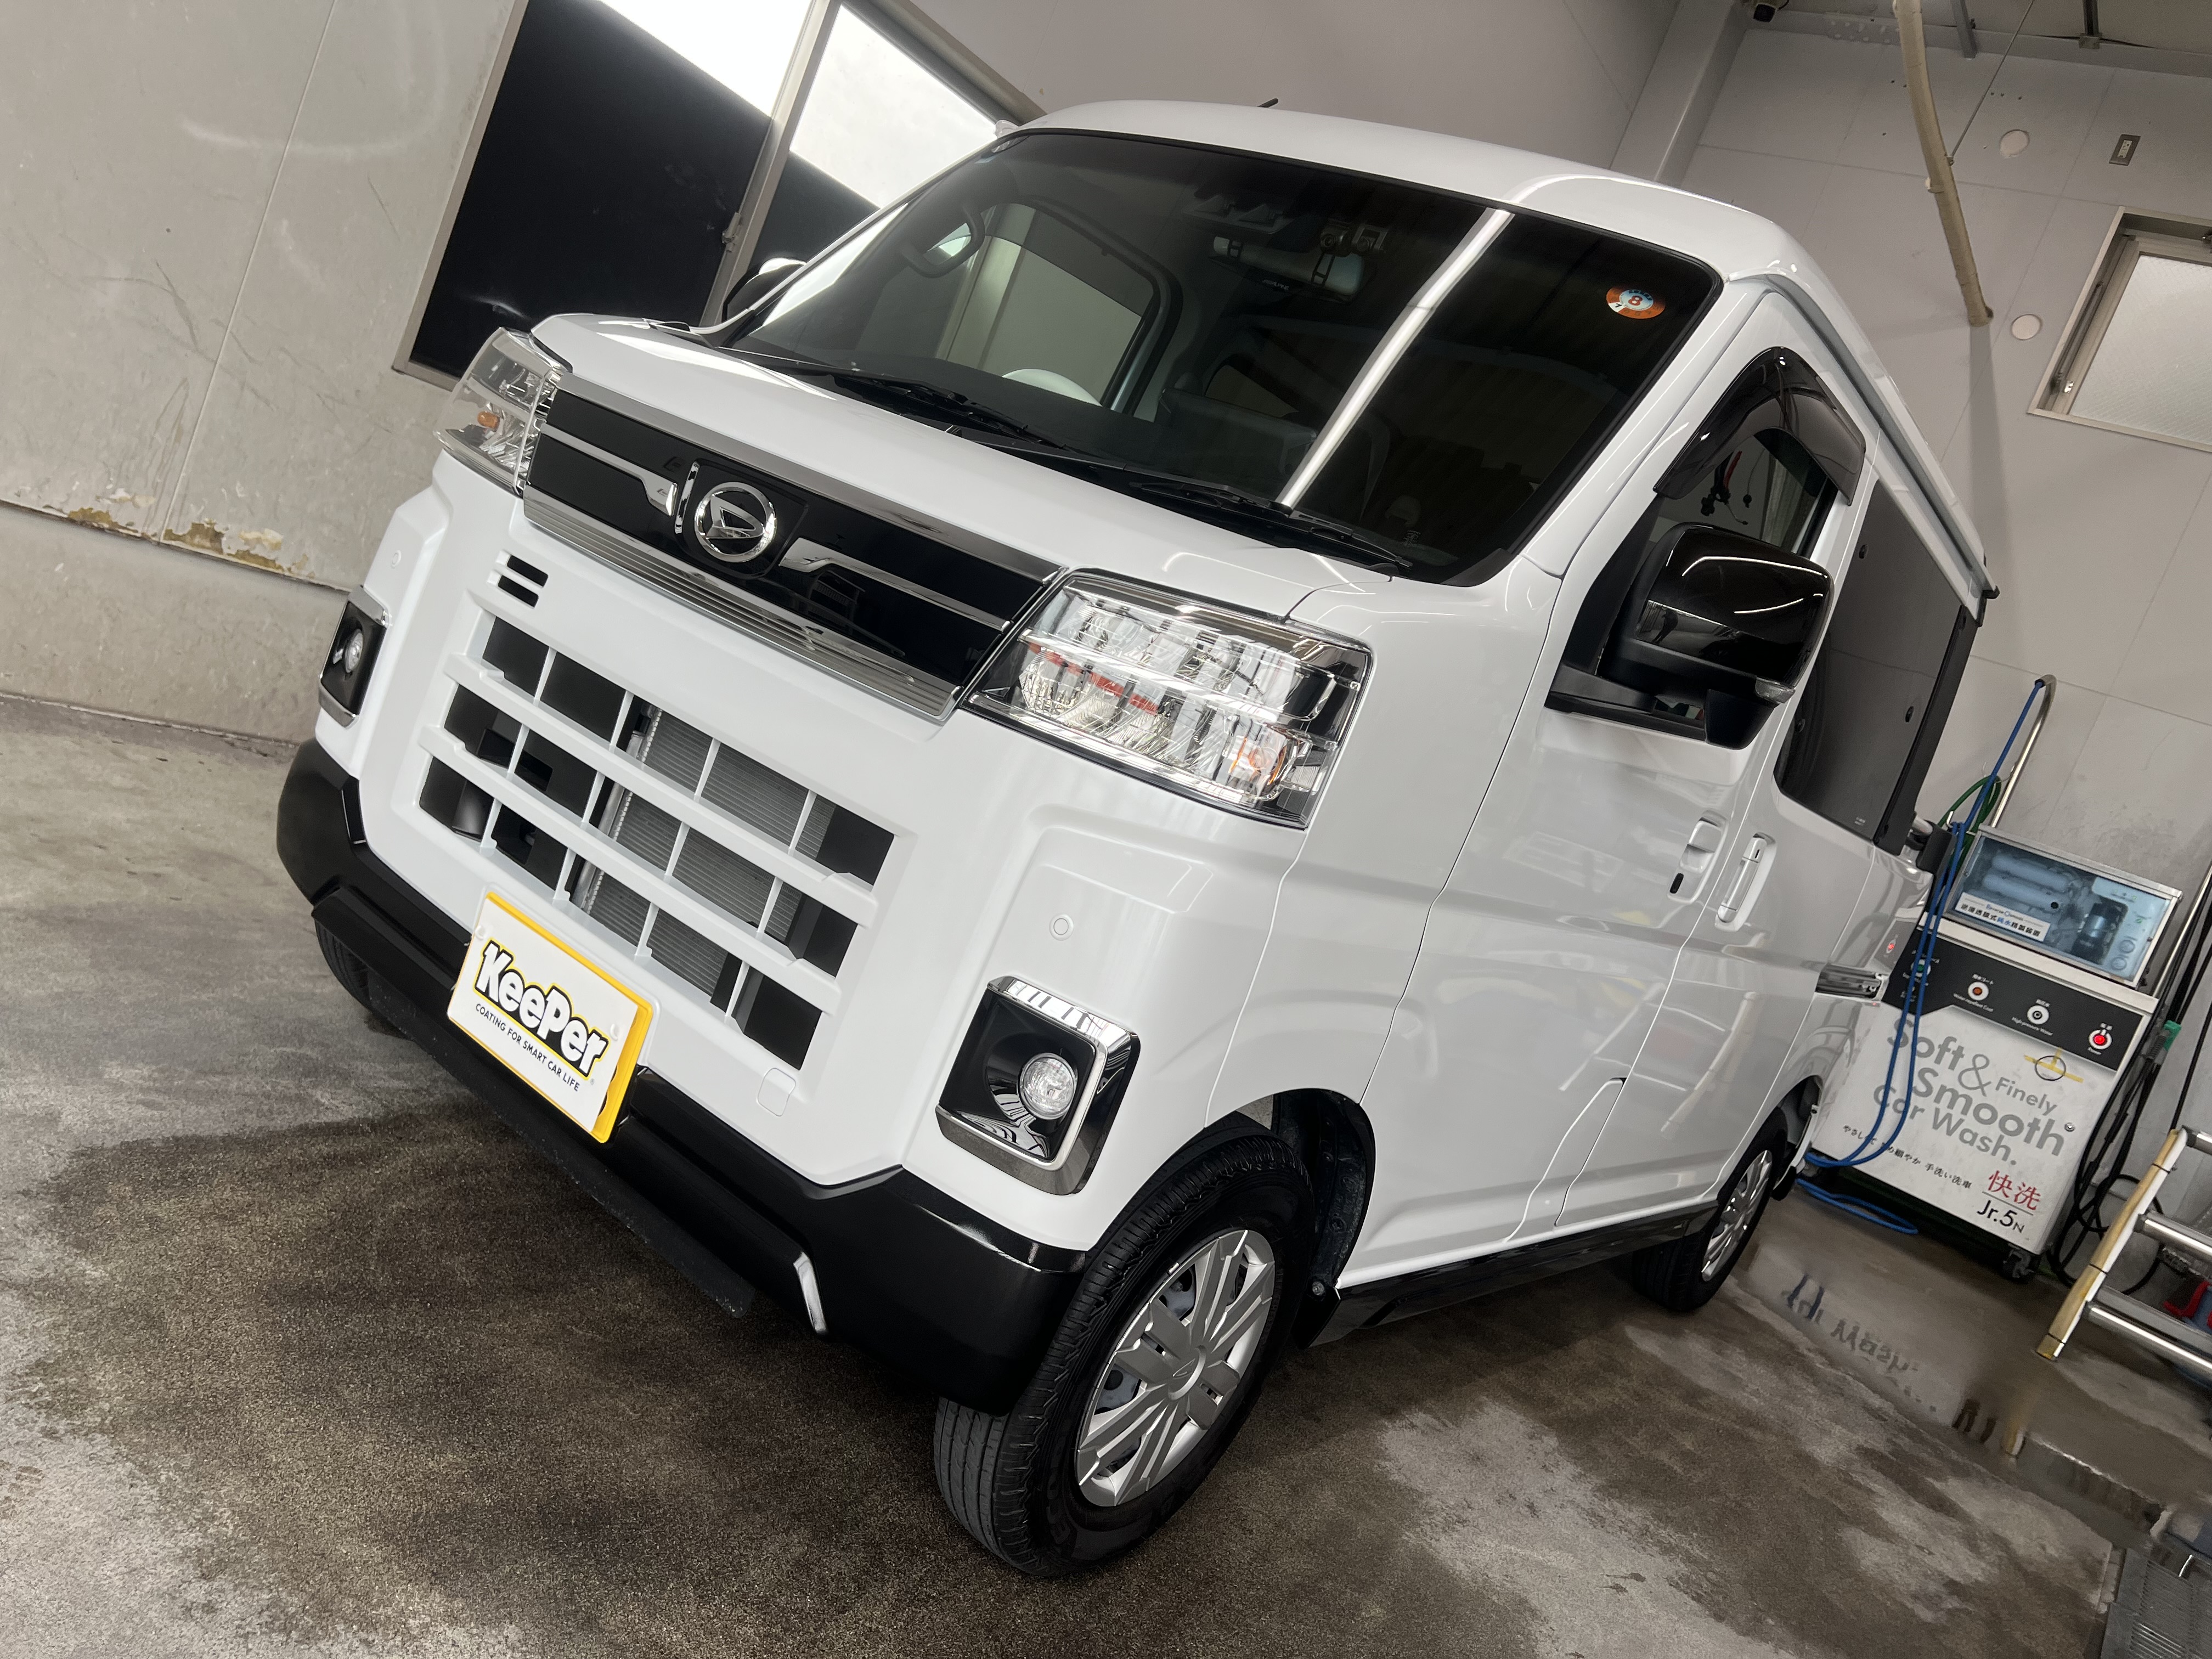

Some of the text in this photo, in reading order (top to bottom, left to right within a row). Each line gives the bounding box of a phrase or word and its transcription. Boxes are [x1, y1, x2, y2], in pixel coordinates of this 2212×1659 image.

[1628, 295, 1643, 306] 8
[474, 939, 610, 1079] KeePer
[475, 1003, 580, 1092] COATING FOR SMART CAR LIFE
[1887, 1018, 2057, 1116] Soft & Finely
[1874, 1085, 2017, 1166] Car Wash.
[1913, 1067, 2064, 1156] Smooth
[1842, 1125, 1878, 1146] やさして
[1925, 1162, 1973, 1190] 手洗い洗車
[1988, 1170, 2041, 1210] 快洗
